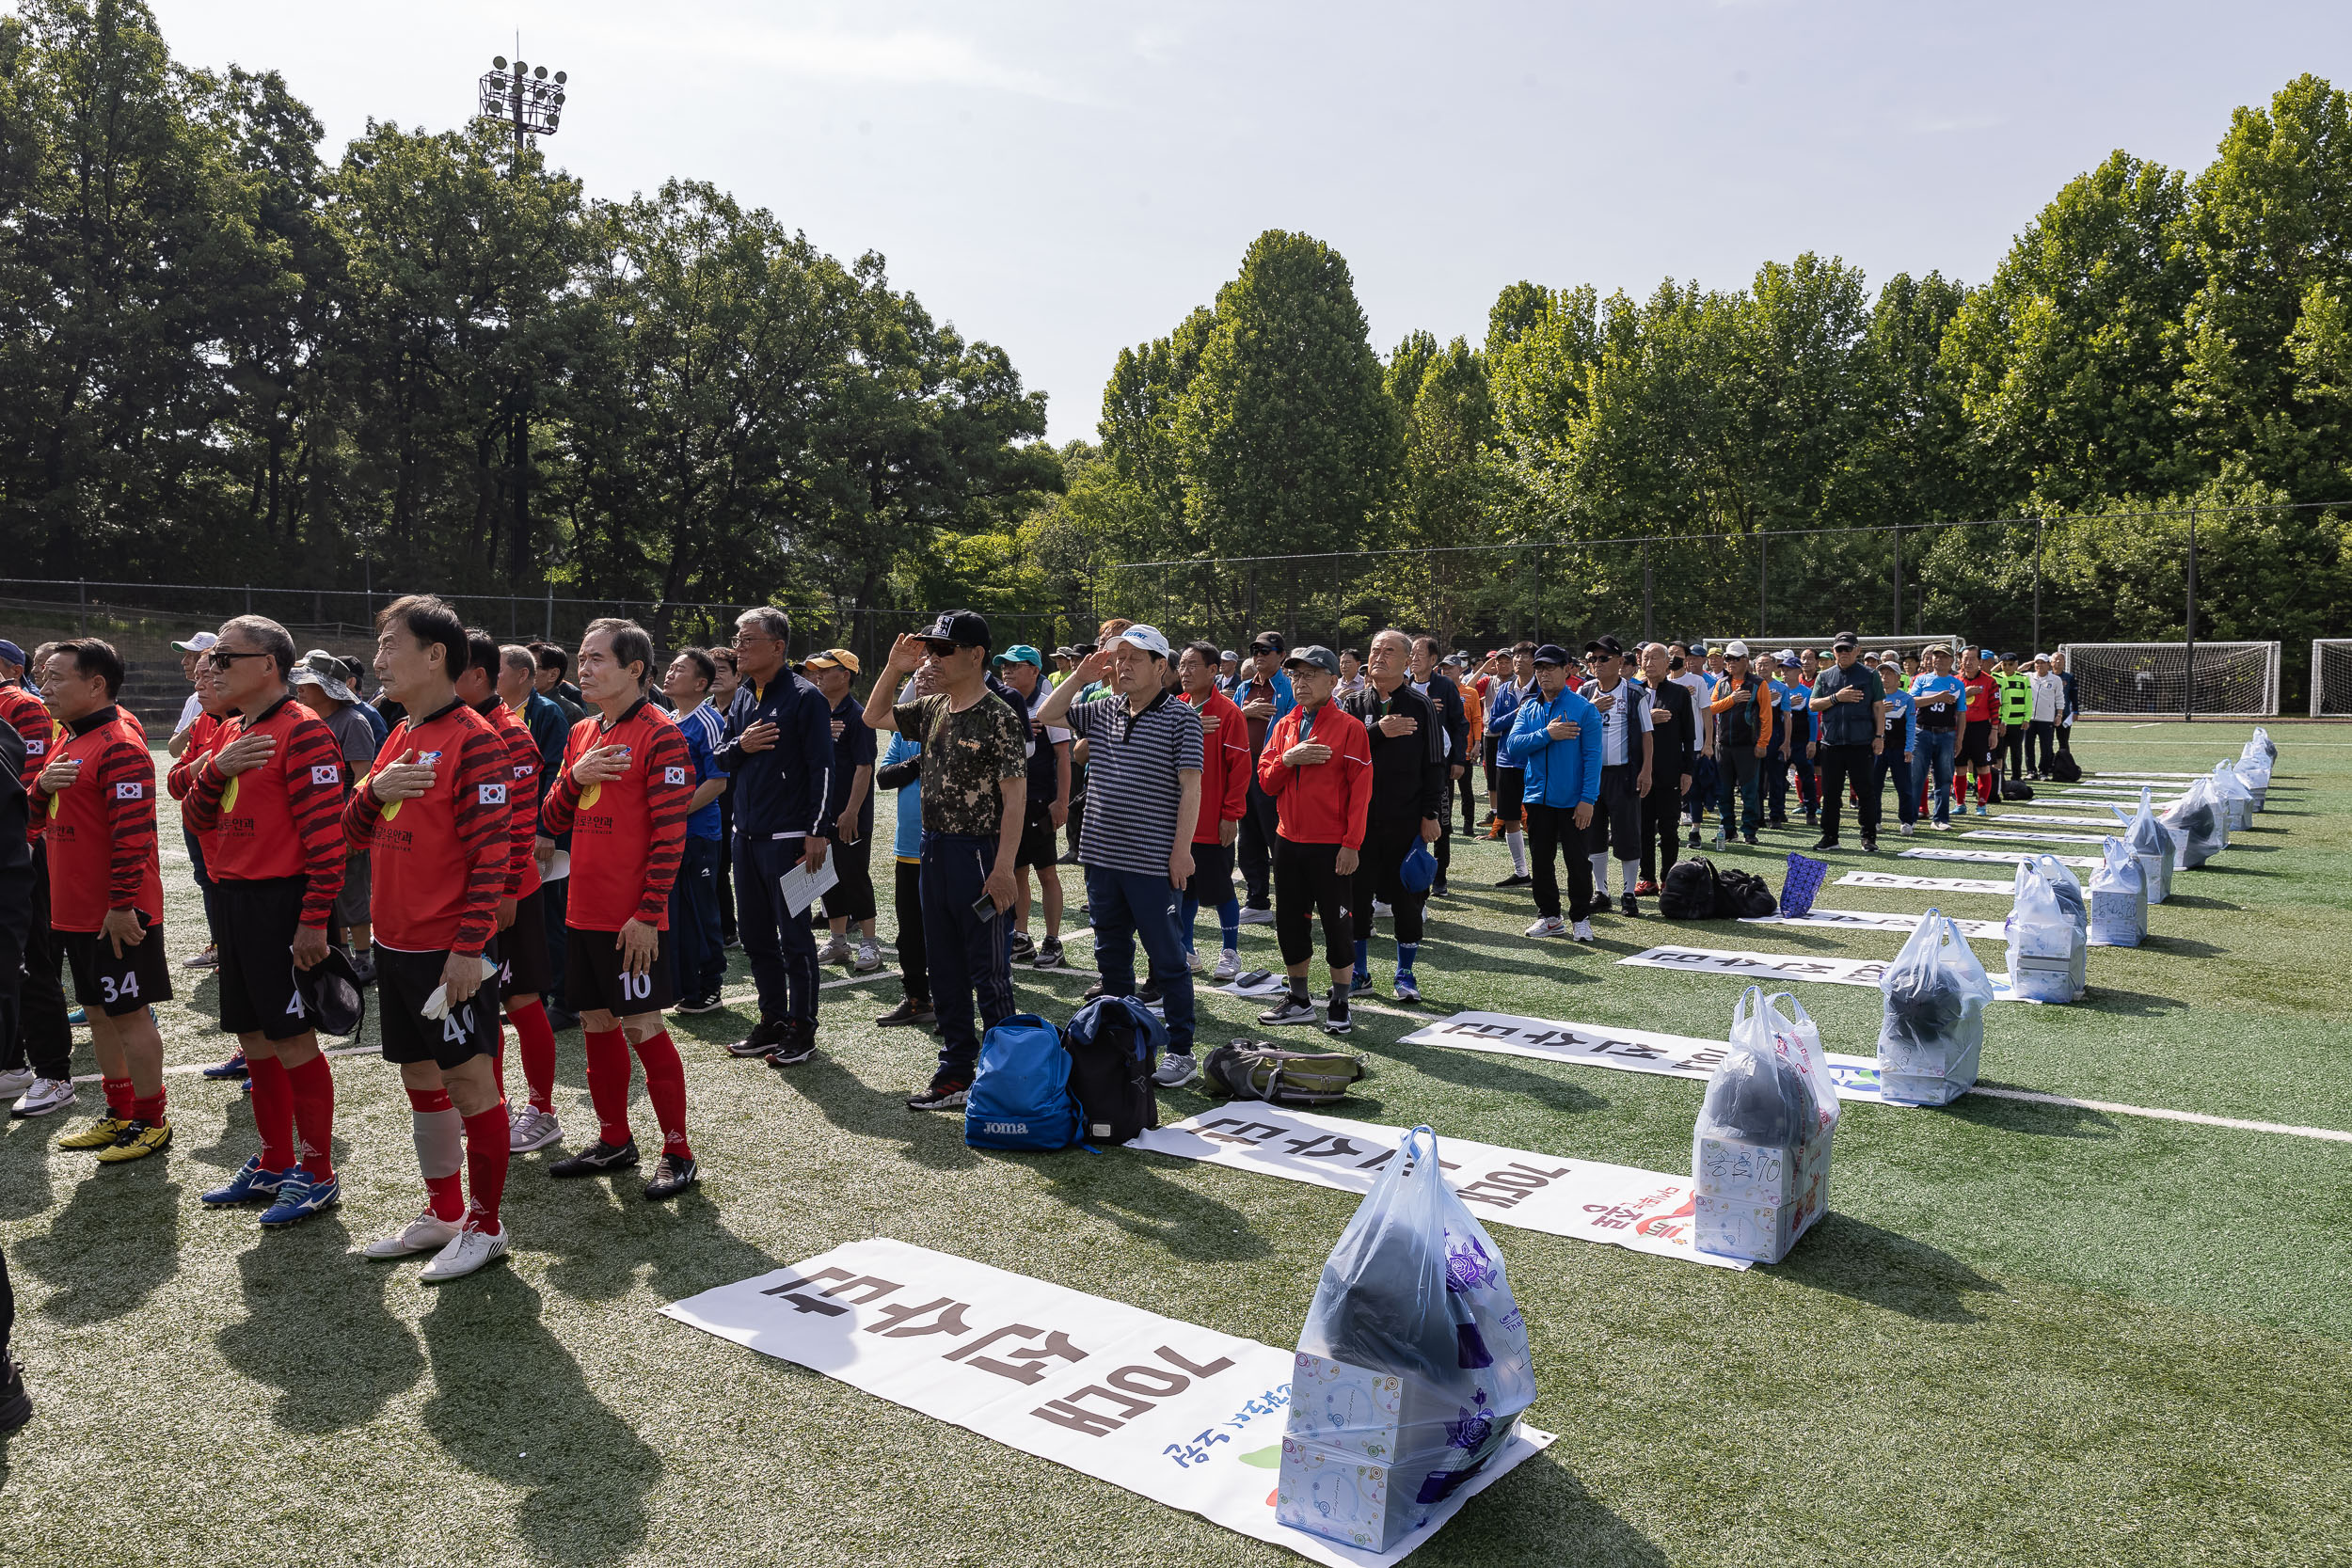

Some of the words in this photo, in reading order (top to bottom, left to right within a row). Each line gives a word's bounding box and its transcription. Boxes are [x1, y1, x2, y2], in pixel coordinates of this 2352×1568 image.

[1986, 752, 1992, 762] 8
[101, 971, 139, 1003] 34
[619, 970, 651, 1001] 10
[443, 1004, 474, 1046] 40
[1442, 1022, 1669, 1060] 선수단
[1756, 1155, 1781, 1181] 70
[1582, 1204, 1644, 1229] 종로
[760, 1266, 1089, 1386] 선수단
[1029, 1344, 1235, 1438] 70대
[1162, 1428, 1231, 1468] 노원
